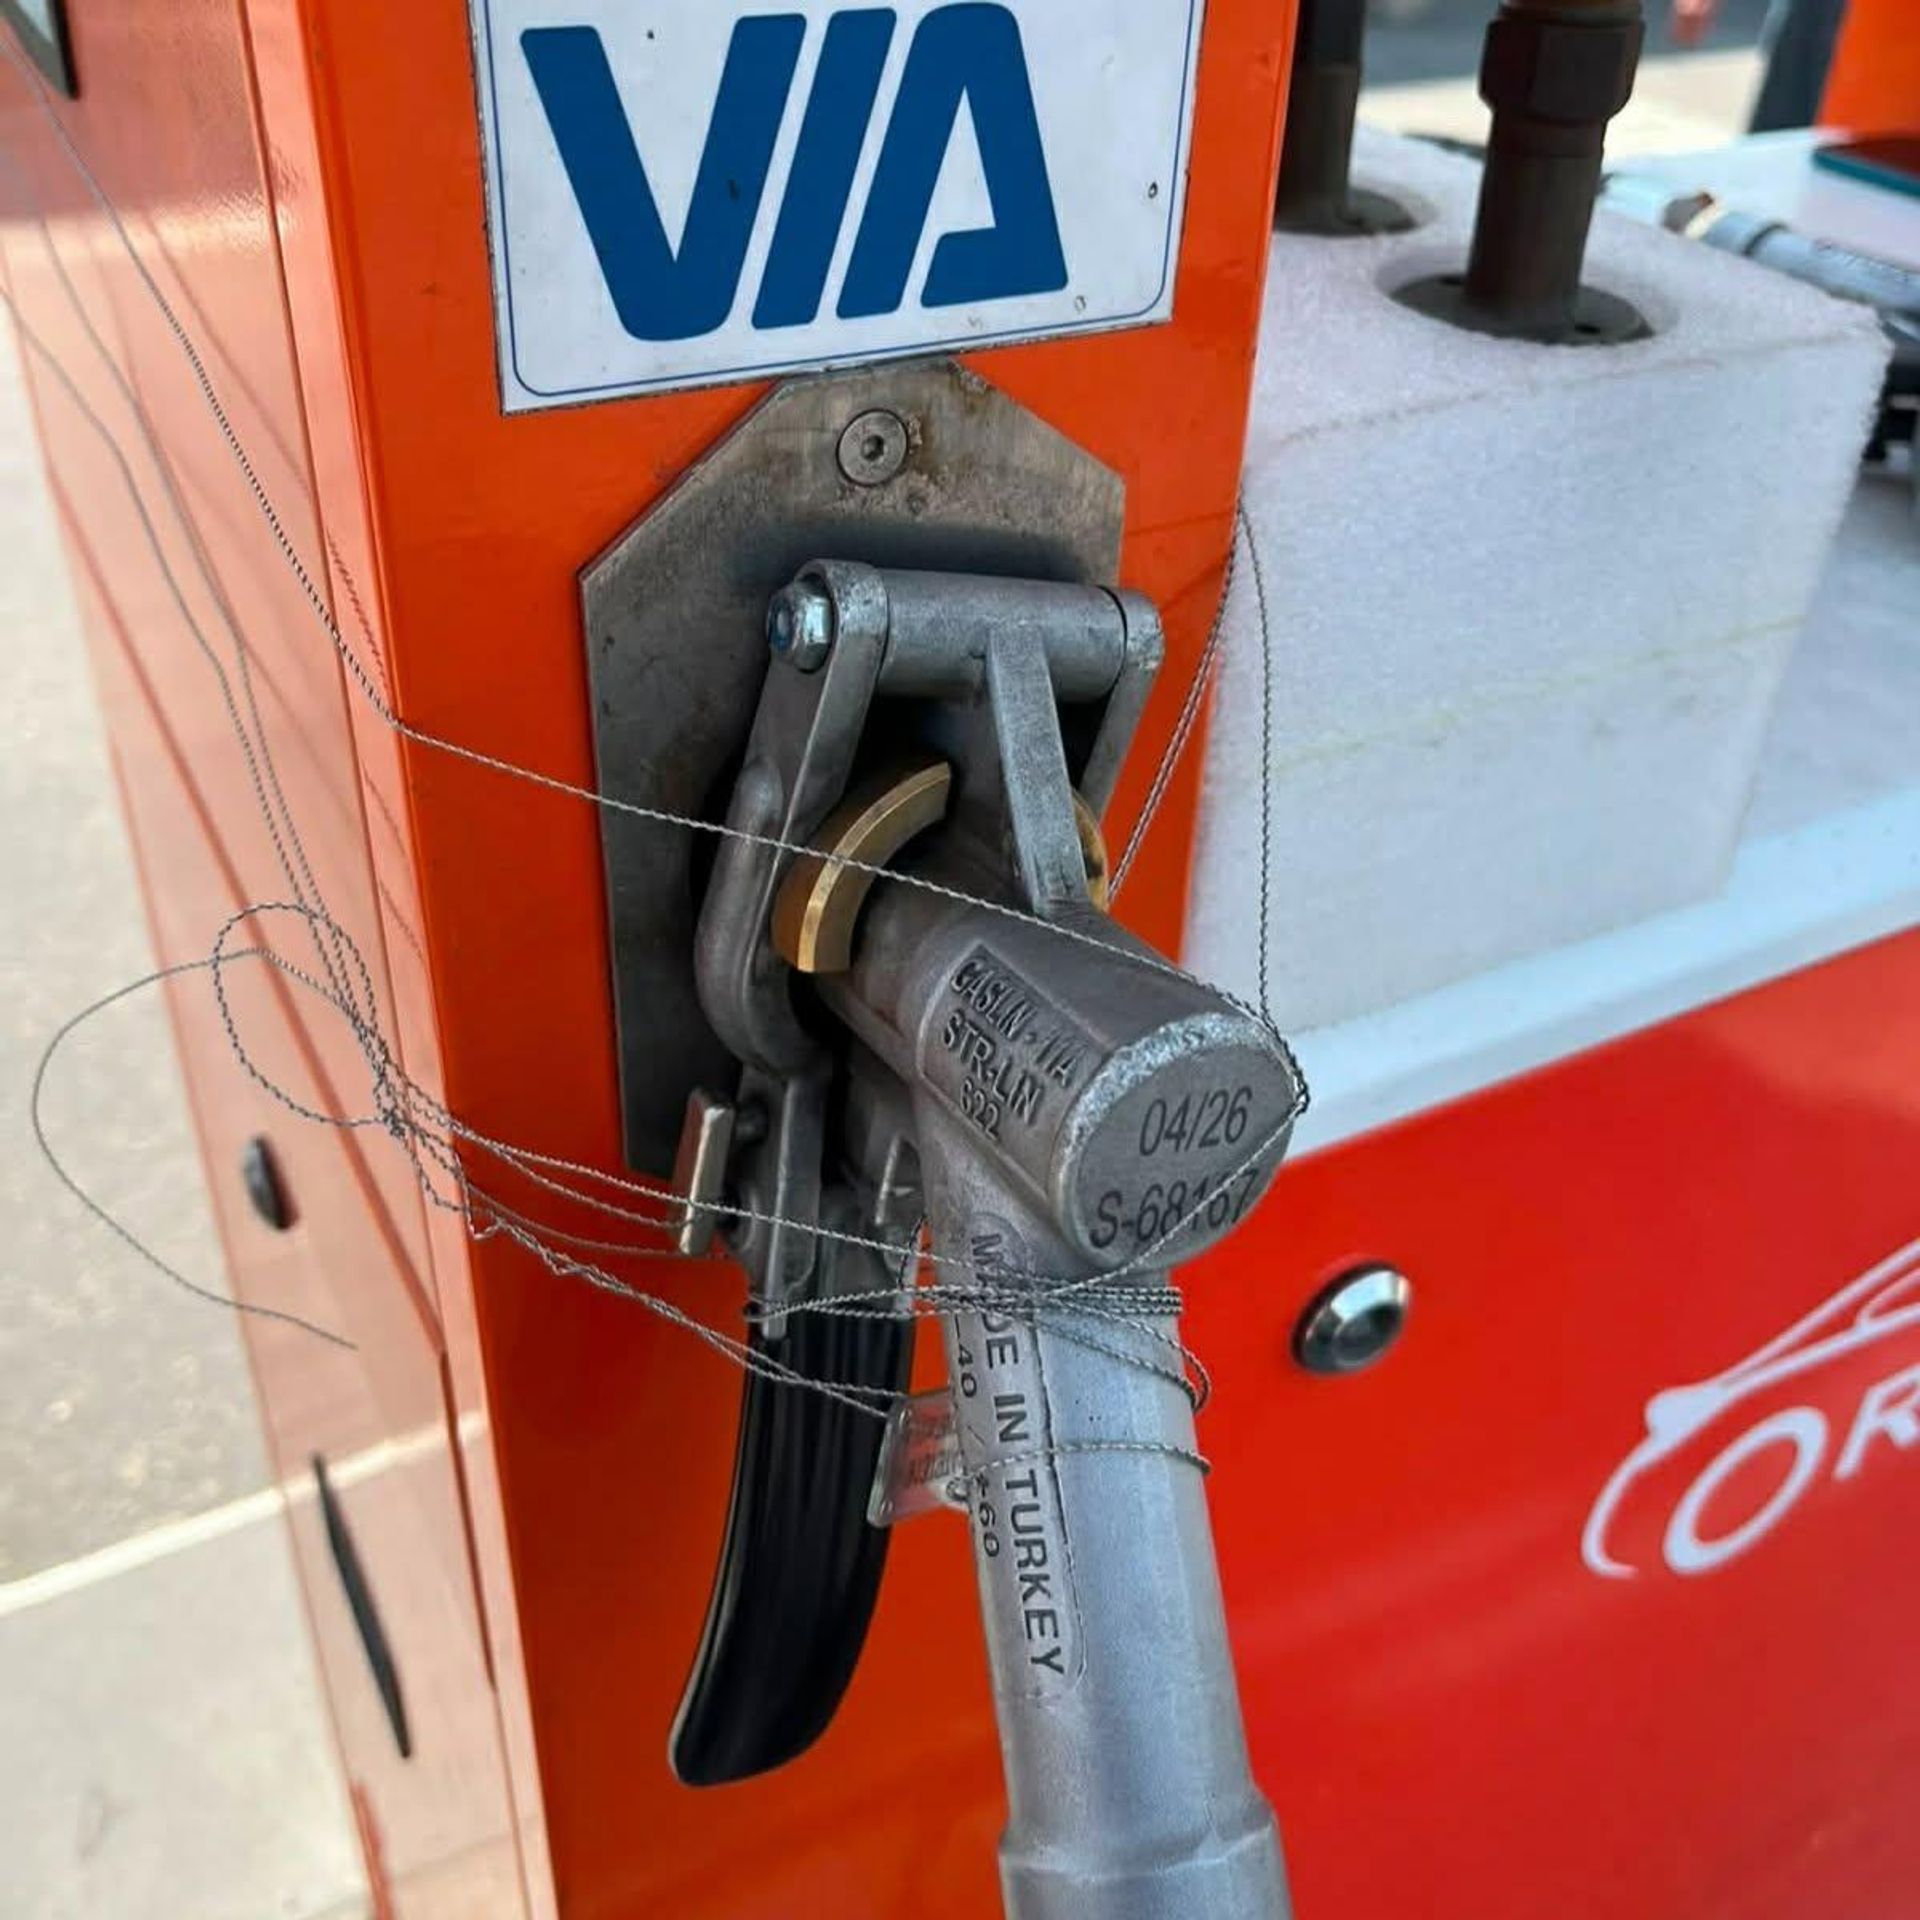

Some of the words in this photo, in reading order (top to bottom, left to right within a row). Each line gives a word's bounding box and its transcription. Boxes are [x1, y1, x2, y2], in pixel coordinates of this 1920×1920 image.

[520, 2, 1068, 342] VIA
[960, 1076, 1000, 1142] 622
[1139, 1085, 1252, 1156] 04/26
[1089, 1168, 1259, 1248] S-68167
[993, 1394, 1031, 1442] IN
[1005, 1469, 1065, 1675] TURKEY
